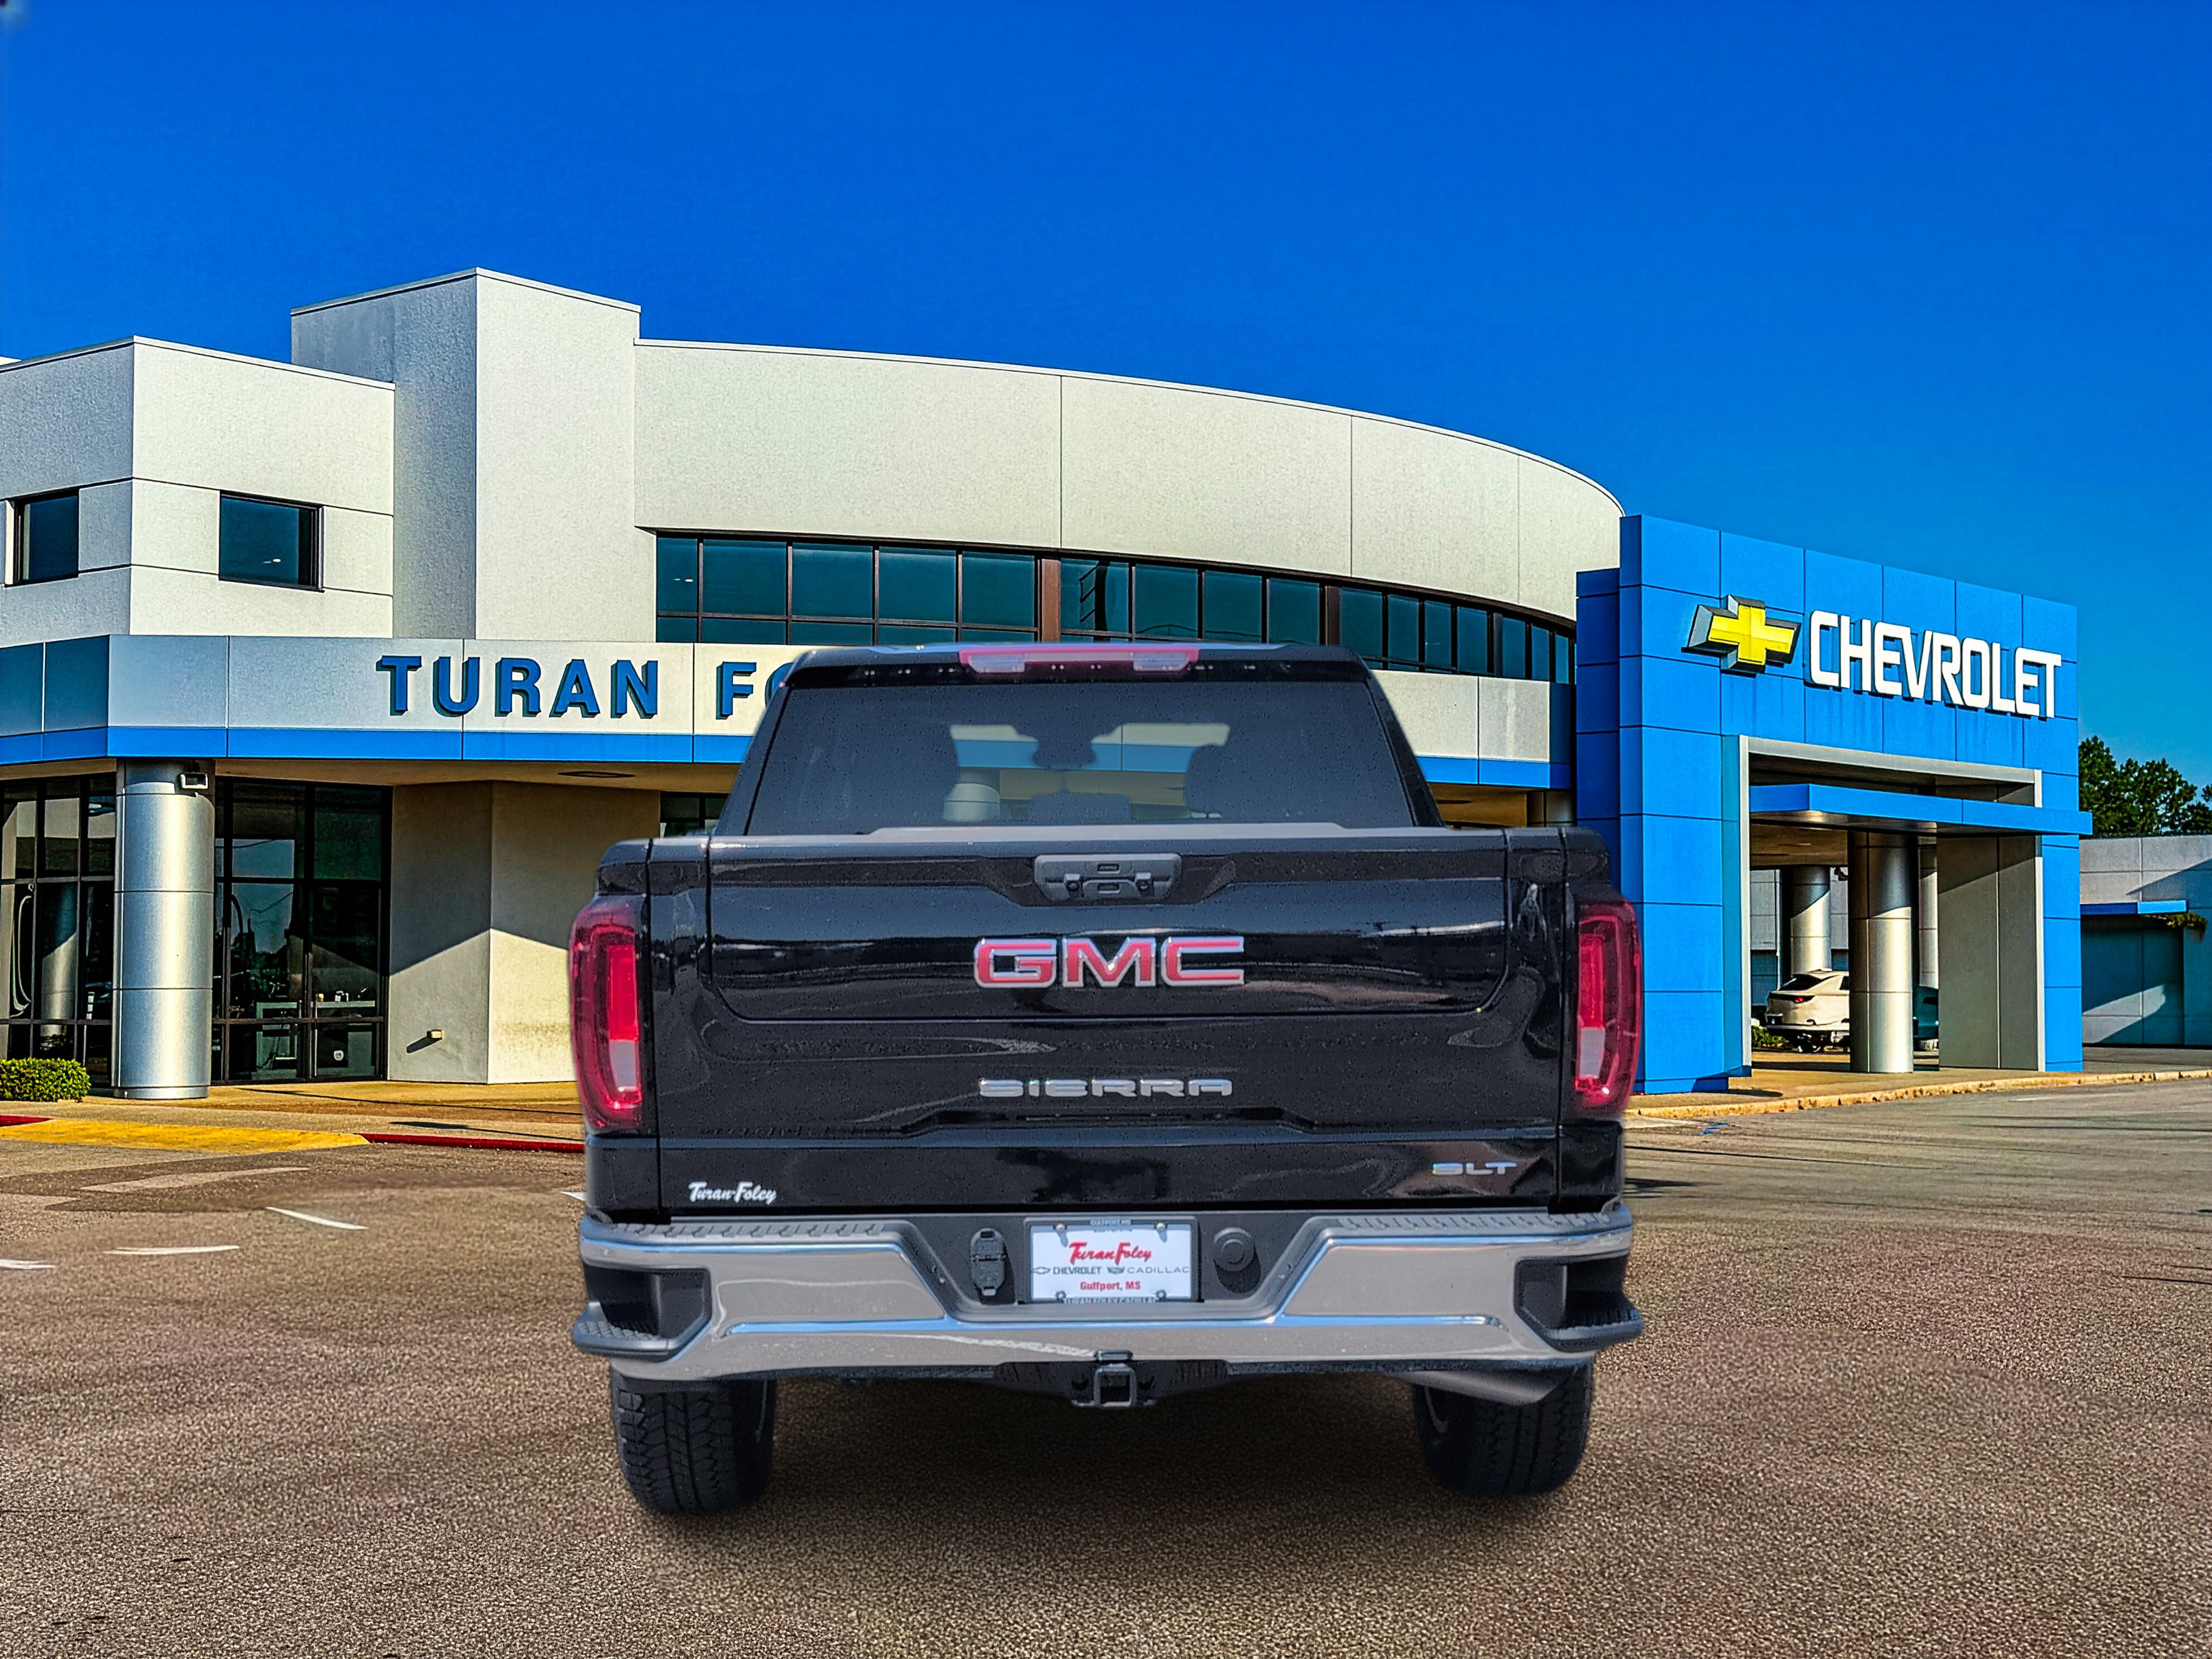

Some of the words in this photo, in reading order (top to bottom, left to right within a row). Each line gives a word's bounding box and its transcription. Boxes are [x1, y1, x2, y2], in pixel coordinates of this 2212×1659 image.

[1807, 610, 2062, 720] CHEVROLET
[376, 655, 658, 719] TURAN
[974, 936, 1244, 988] GMC
[979, 1079, 1233, 1097] SIERRA
[1431, 1162, 1517, 1175] SLT
[1053, 1266, 1102, 1275] CHEVROLET
[1127, 1266, 1190, 1274] CADILLAC
[1125, 1281, 1141, 1290] MS
